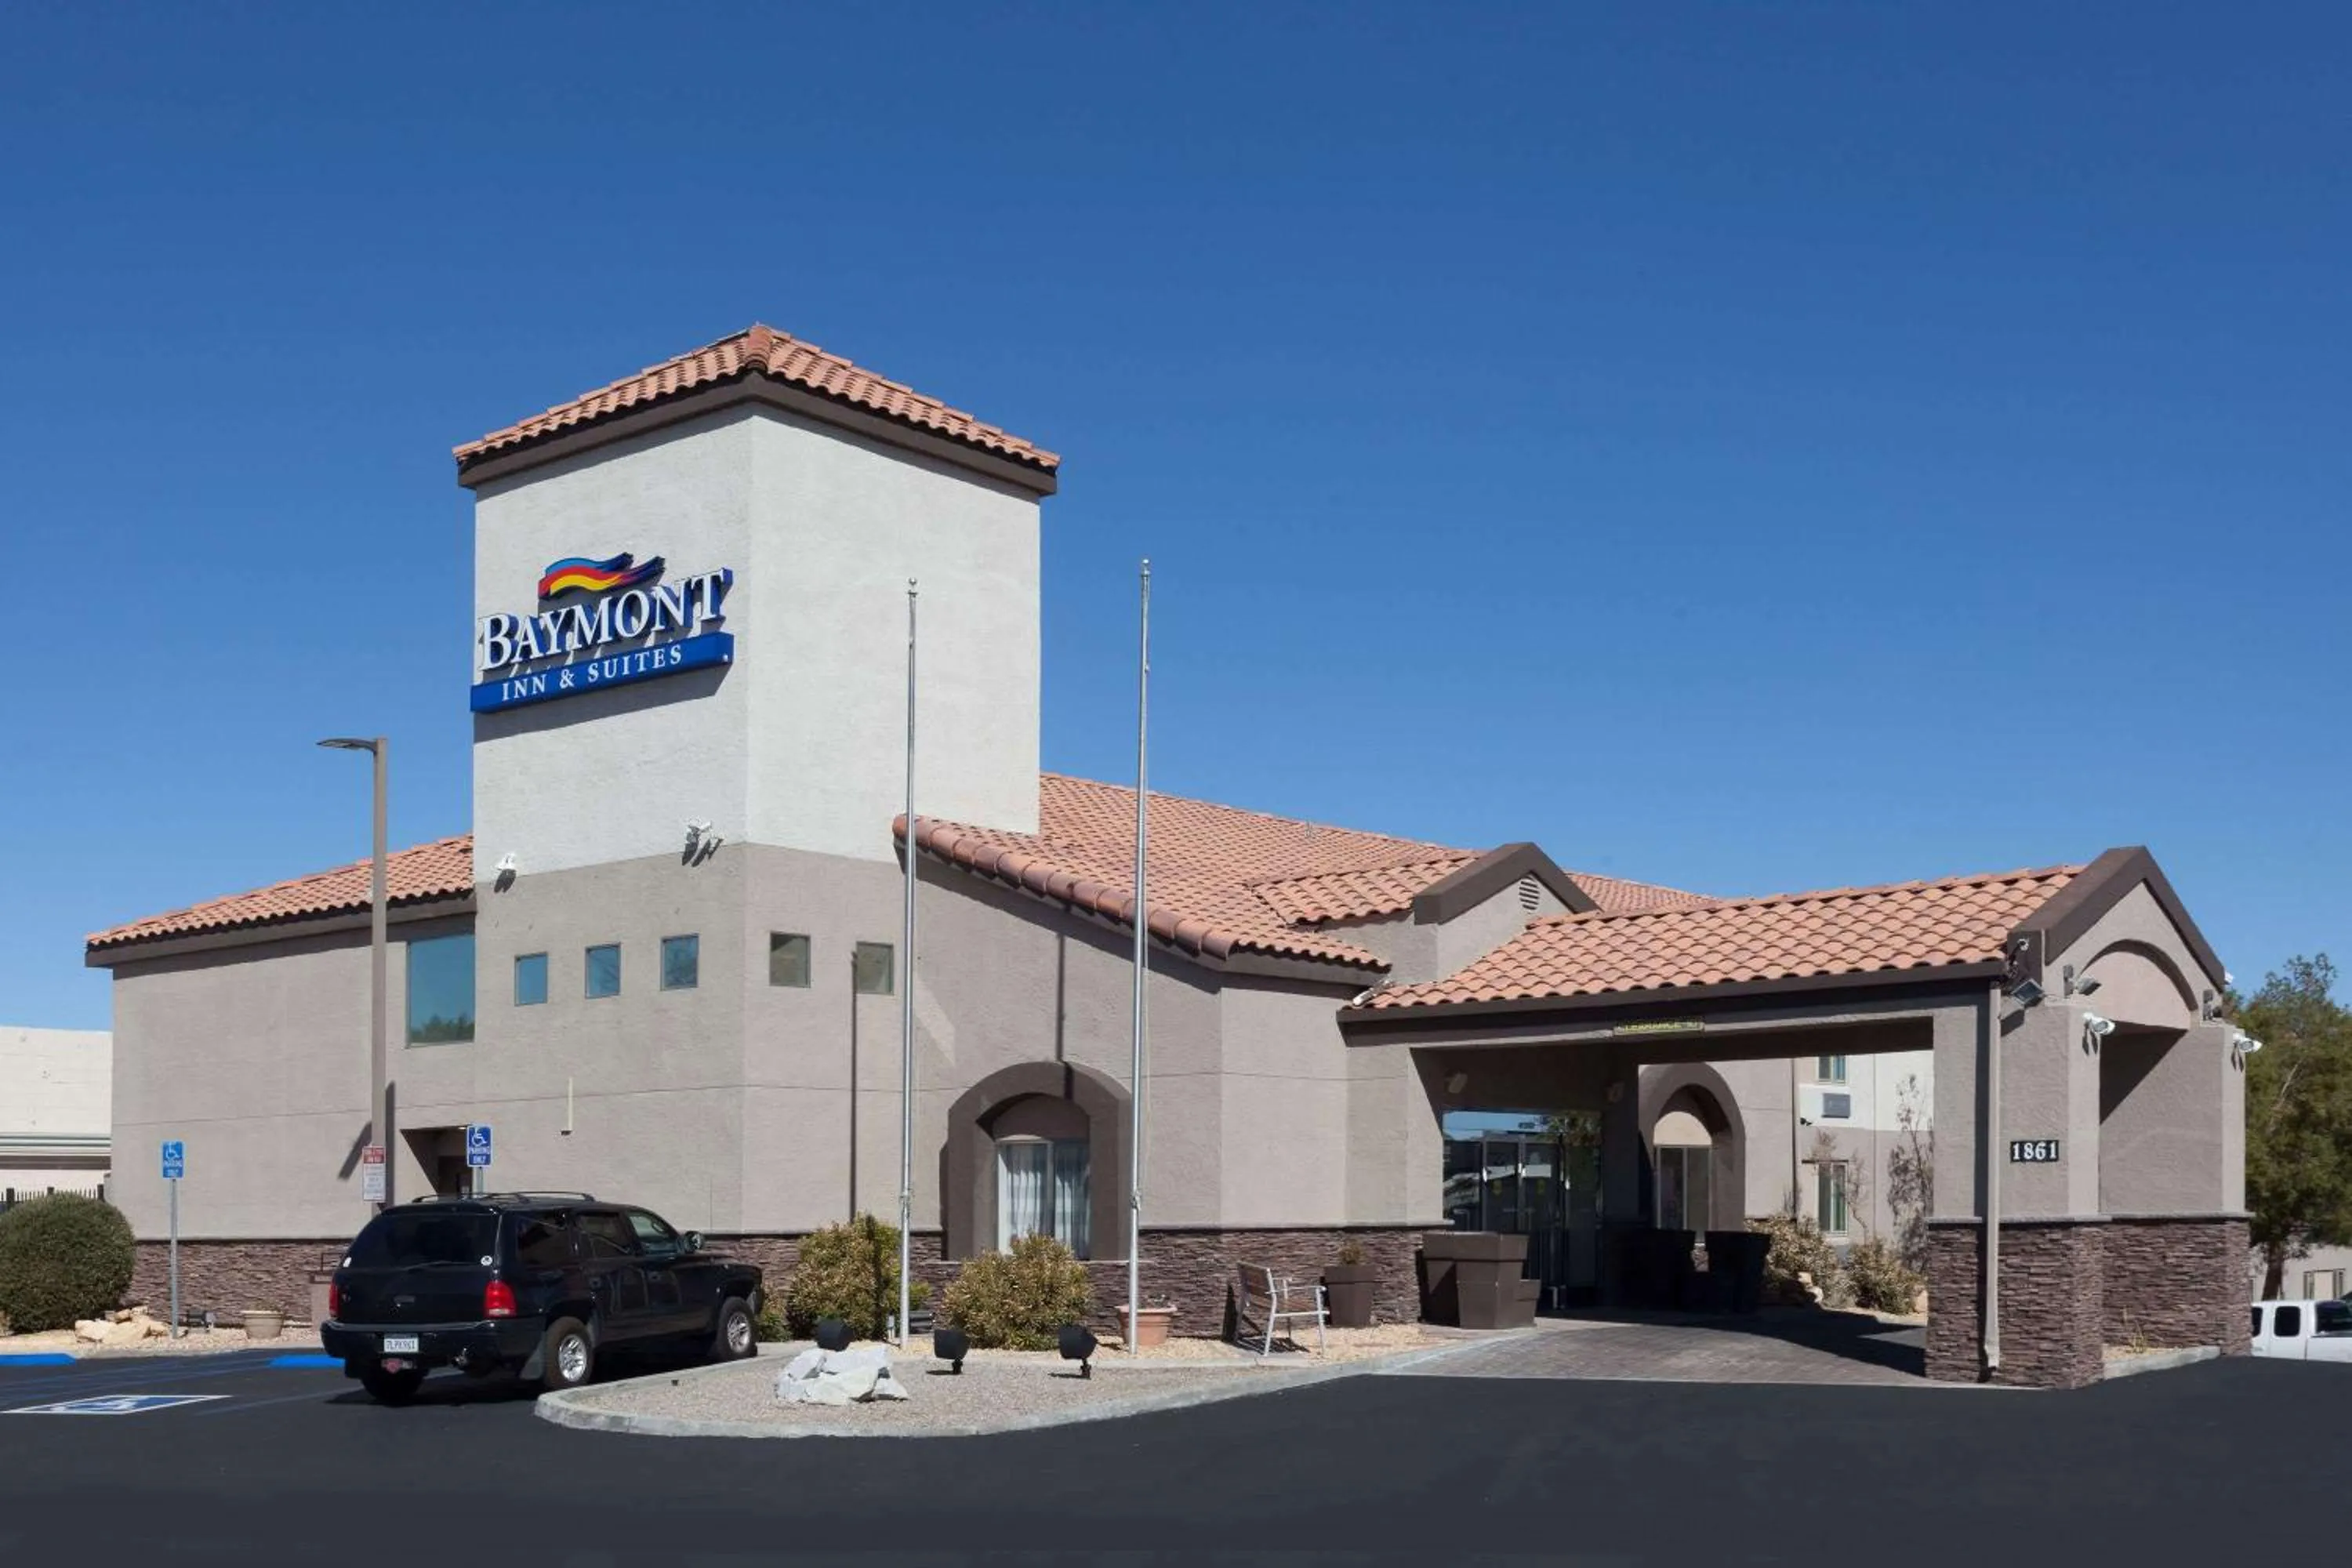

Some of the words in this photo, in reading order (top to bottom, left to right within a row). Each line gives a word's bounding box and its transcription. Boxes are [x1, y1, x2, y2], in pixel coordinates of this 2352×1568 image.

[479, 570, 725, 670] BAYMONT
[502, 673, 547, 701] INN
[559, 669, 575, 688] &
[588, 644, 681, 682] SUITES
[2013, 1142, 2056, 1160] 1861
